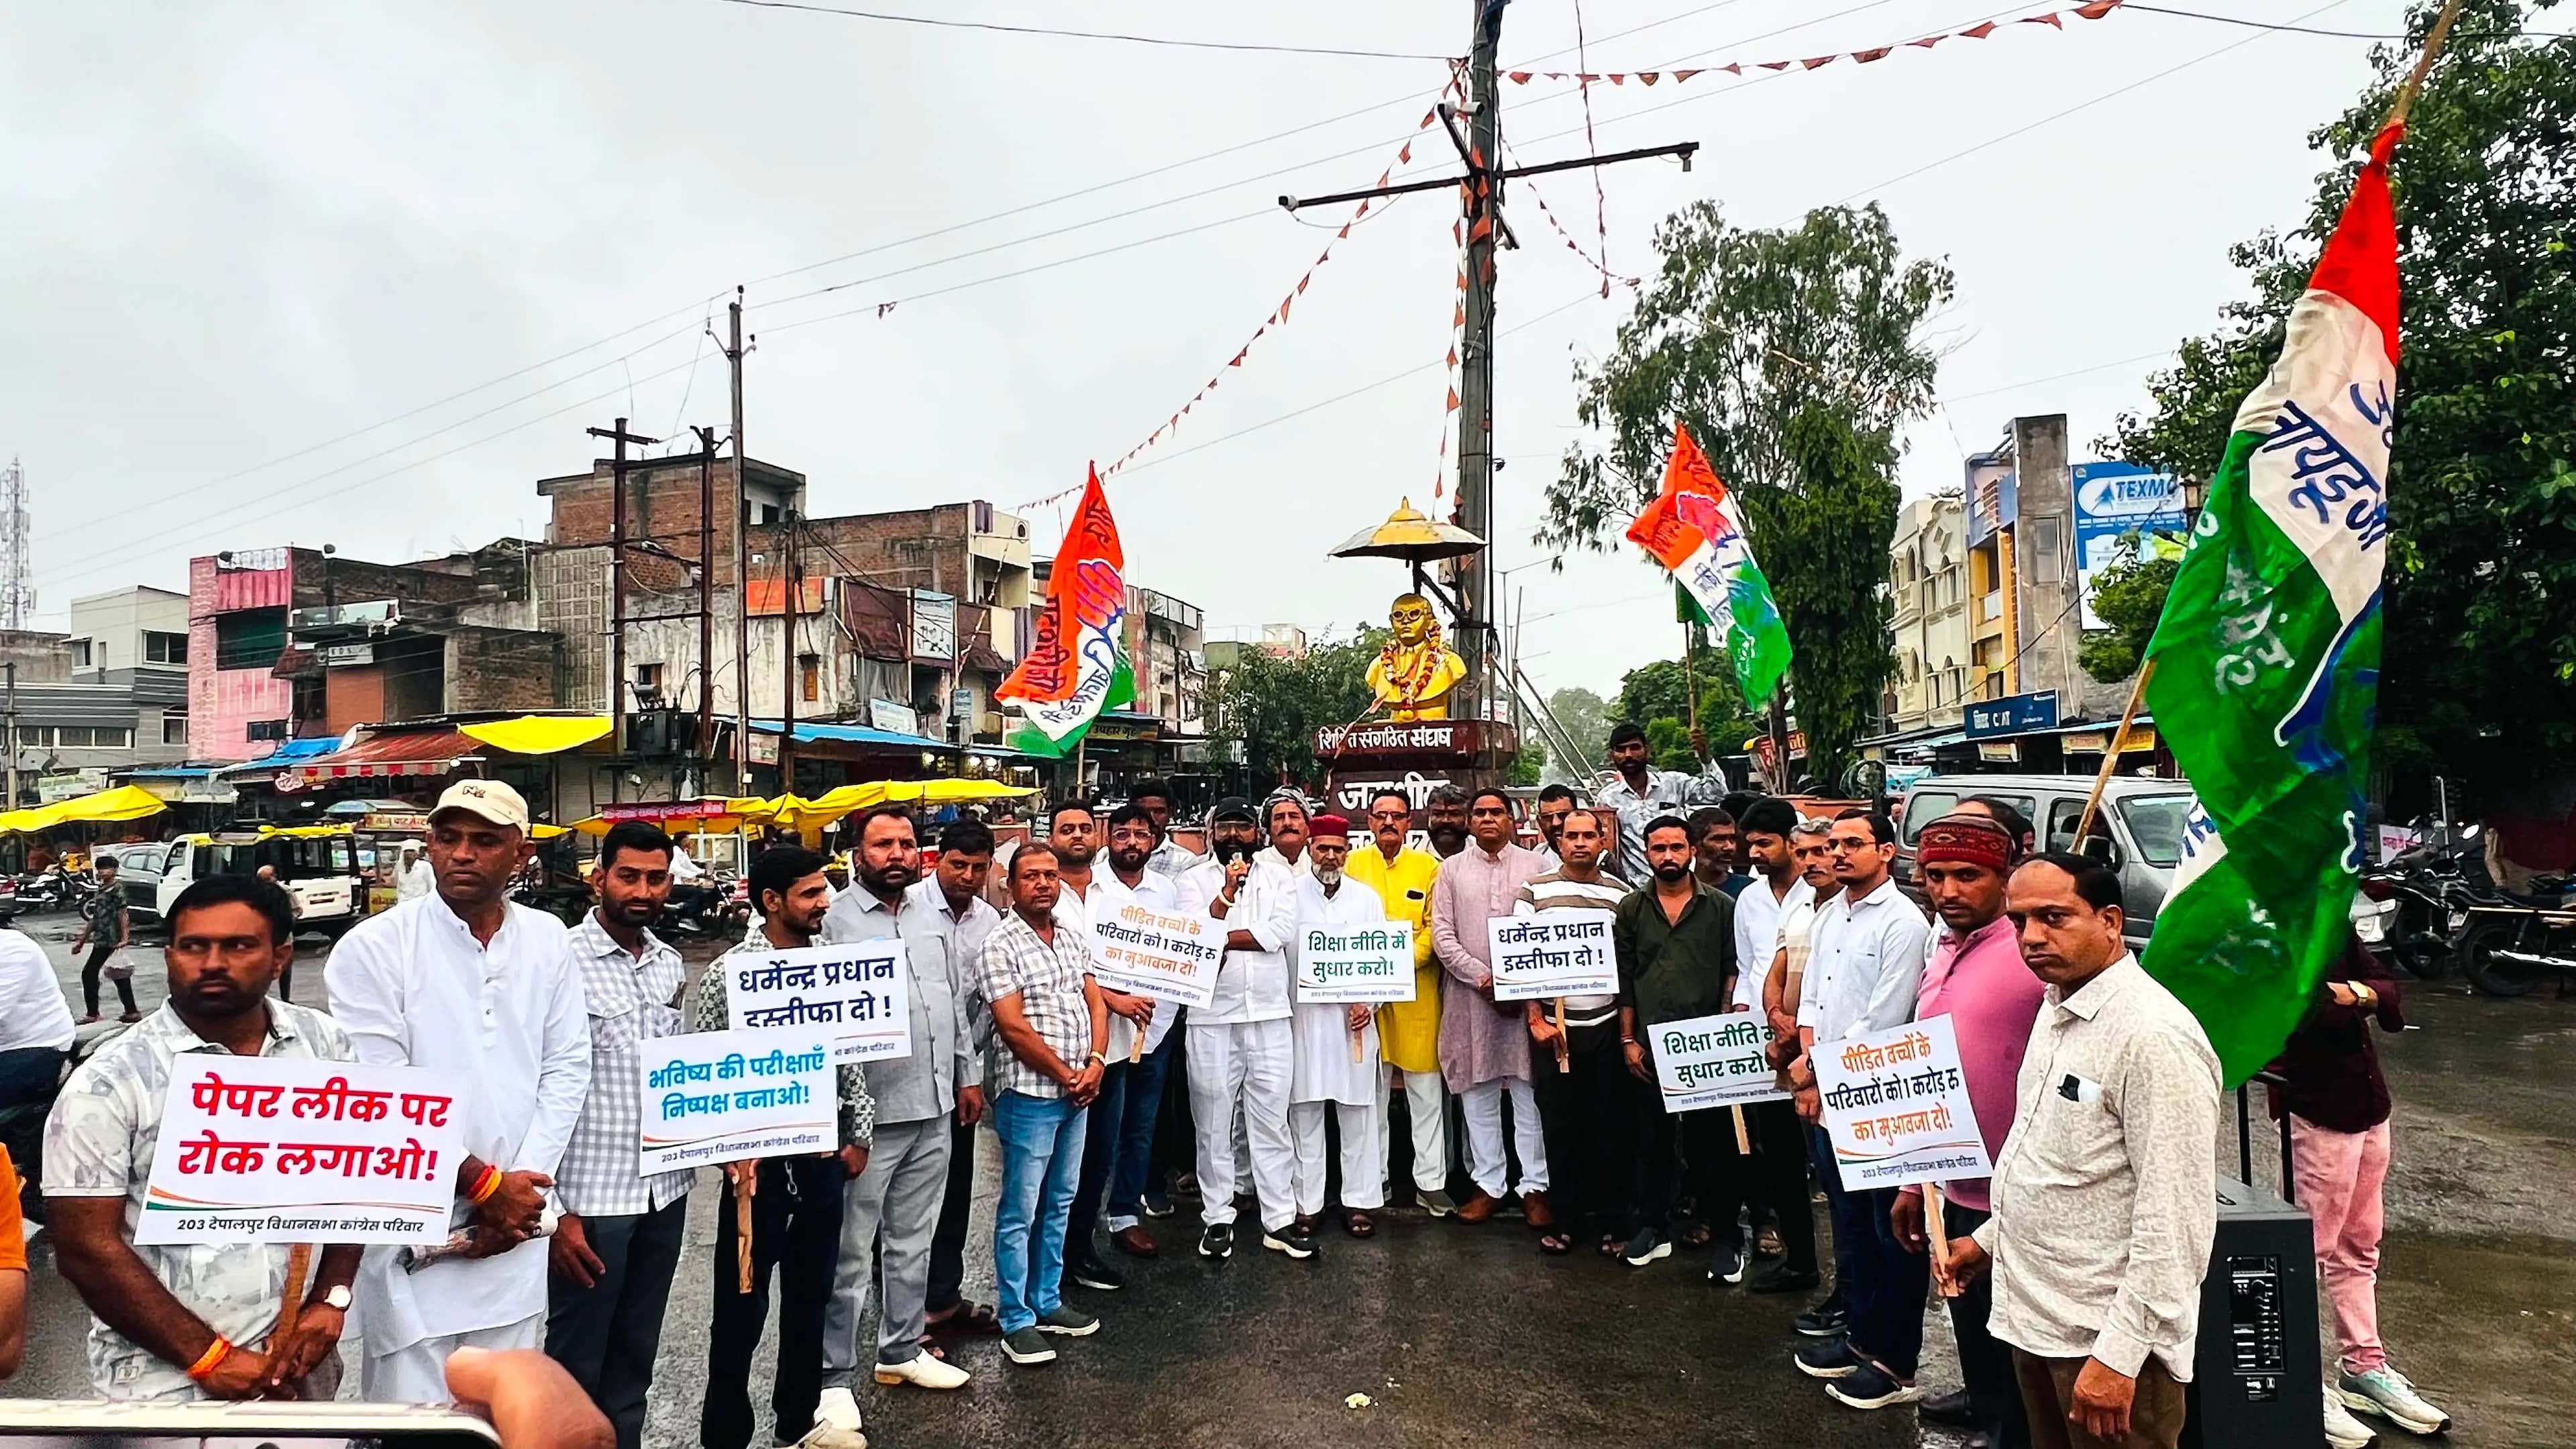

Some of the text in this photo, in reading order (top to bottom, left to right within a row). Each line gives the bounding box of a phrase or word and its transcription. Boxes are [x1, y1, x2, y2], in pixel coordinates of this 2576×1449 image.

[1358, 725, 1409, 749] संगठित
[1120, 906, 1155, 927] पीड़ित
[1189, 919, 1203, 936] के
[1498, 922, 1605, 944] धर्मेन्द्र प्रधान
[1096, 922, 1144, 945] परिवारों
[1143, 932, 1161, 949] को
[1163, 938, 1168, 950] 1
[1171, 939, 1203, 962] करोड़
[1308, 930, 1408, 952] शिक्षा नीति में
[739, 957, 895, 993] धर्मेन्द्र प्रधान
[1106, 946, 1197, 977] का मुआवजा दो!
[1313, 956, 1394, 983] सुधार करो!
[1503, 948, 1570, 973] इस्तीफा
[1574, 945, 1592, 967] दो
[849, 990, 875, 1022] दो
[1663, 1031, 1712, 1055] शिक्षा
[1713, 1021, 1760, 1048] नीति
[1841, 1031, 1932, 1075] पीड़ित बच्चों के
[649, 1045, 825, 1088] भविष्य की परीक्षाएँ
[1674, 1061, 1725, 1088] सुधार
[192, 1071, 452, 1127] पेपर लीक पर
[662, 1081, 810, 1121] निष्पक्ष बनाओ!
[1825, 1077, 1883, 1110] परिवारों
[1883, 1073, 1903, 1100] को
[1904, 1079, 1911, 1098] 1
[1911, 1066, 1946, 1099] करोड़
[1851, 1102, 1953, 1146] का मुआवजा दो!
[178, 1130, 437, 1181] रोक लगाओ!
[177, 1216, 424, 1234] 203 देपालपुर विधानसभा कांग्रेस परिवार
